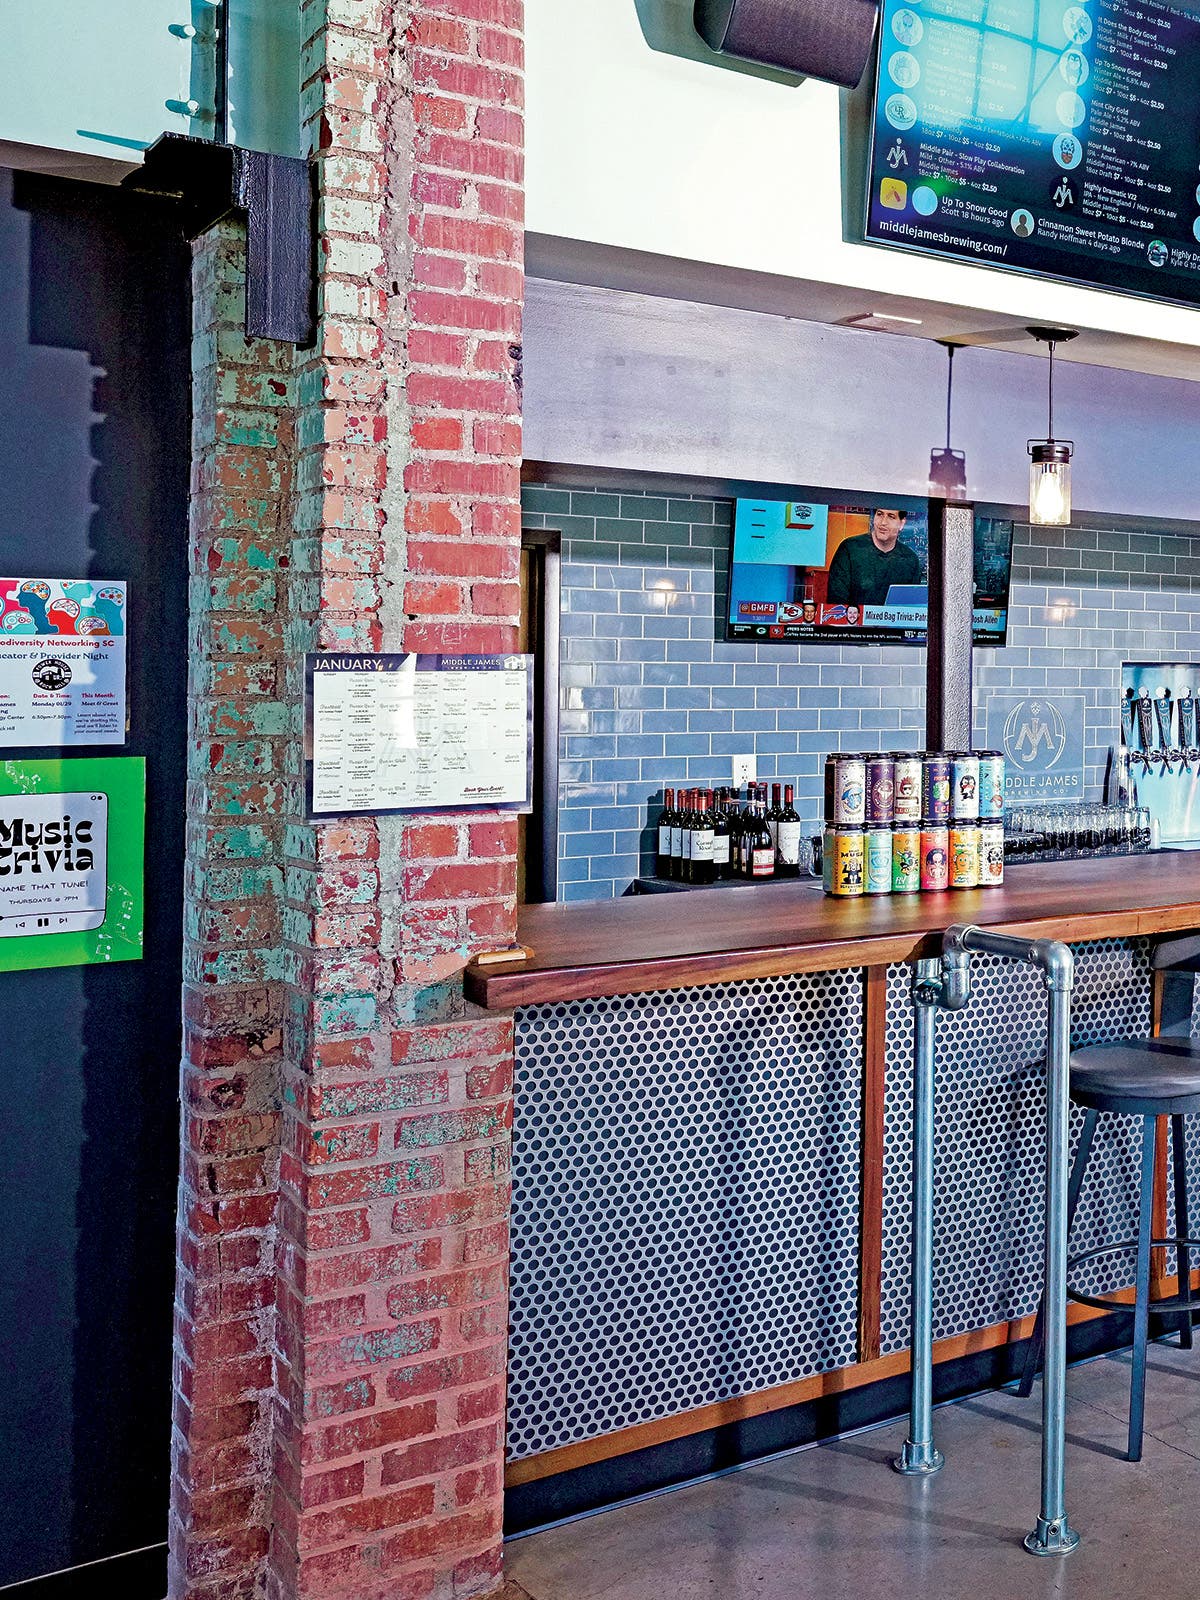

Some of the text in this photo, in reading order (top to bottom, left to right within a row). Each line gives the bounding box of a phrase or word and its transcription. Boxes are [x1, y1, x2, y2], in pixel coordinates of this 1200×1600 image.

[920, 143, 1025, 174] Middle Pair Slow Play Collaboration
[1084, 182, 1137, 201] Highly Dramatic V22
[942, 197, 1008, 218] Up To Snow Good
[1083, 199, 1119, 214] Middle James
[1084, 190, 1177, 219] IPA New England Hazy 6.5% ABV
[941, 207, 1005, 228] Scott 18 hours ago
[1082, 207, 1154, 230] 18oz $7 10oz $5 4oz $2.50
[880, 220, 1008, 256] middlejamesbrewing.com/
[1037, 227, 1121, 254] Randy Hoffman 4 days ago
[1038, 218, 1144, 250] Cinnamon Sweet Potato Blonde
[1171, 249, 1191, 262] Highly
[1170, 257, 1183, 267] Kyle
[1190, 262, 1197, 270] 10
[751, 603, 775, 612] GMFB
[866, 611, 914, 622] Mixed Bag Trivia:
[984, 615, 998, 624] Allen
[47, 639, 99, 648] Networking
[29, 652, 109, 660] & Provider Night
[314, 659, 381, 670] JANUARY
[39, 681, 52, 689] ROCK
[1005, 775, 1078, 787] DDLE JAMES
[0, 815, 94, 846] Music
[31, 883, 56, 891] THAT
[61, 880, 89, 889] TUNE!
[9, 897, 52, 905] THURSDAYS
